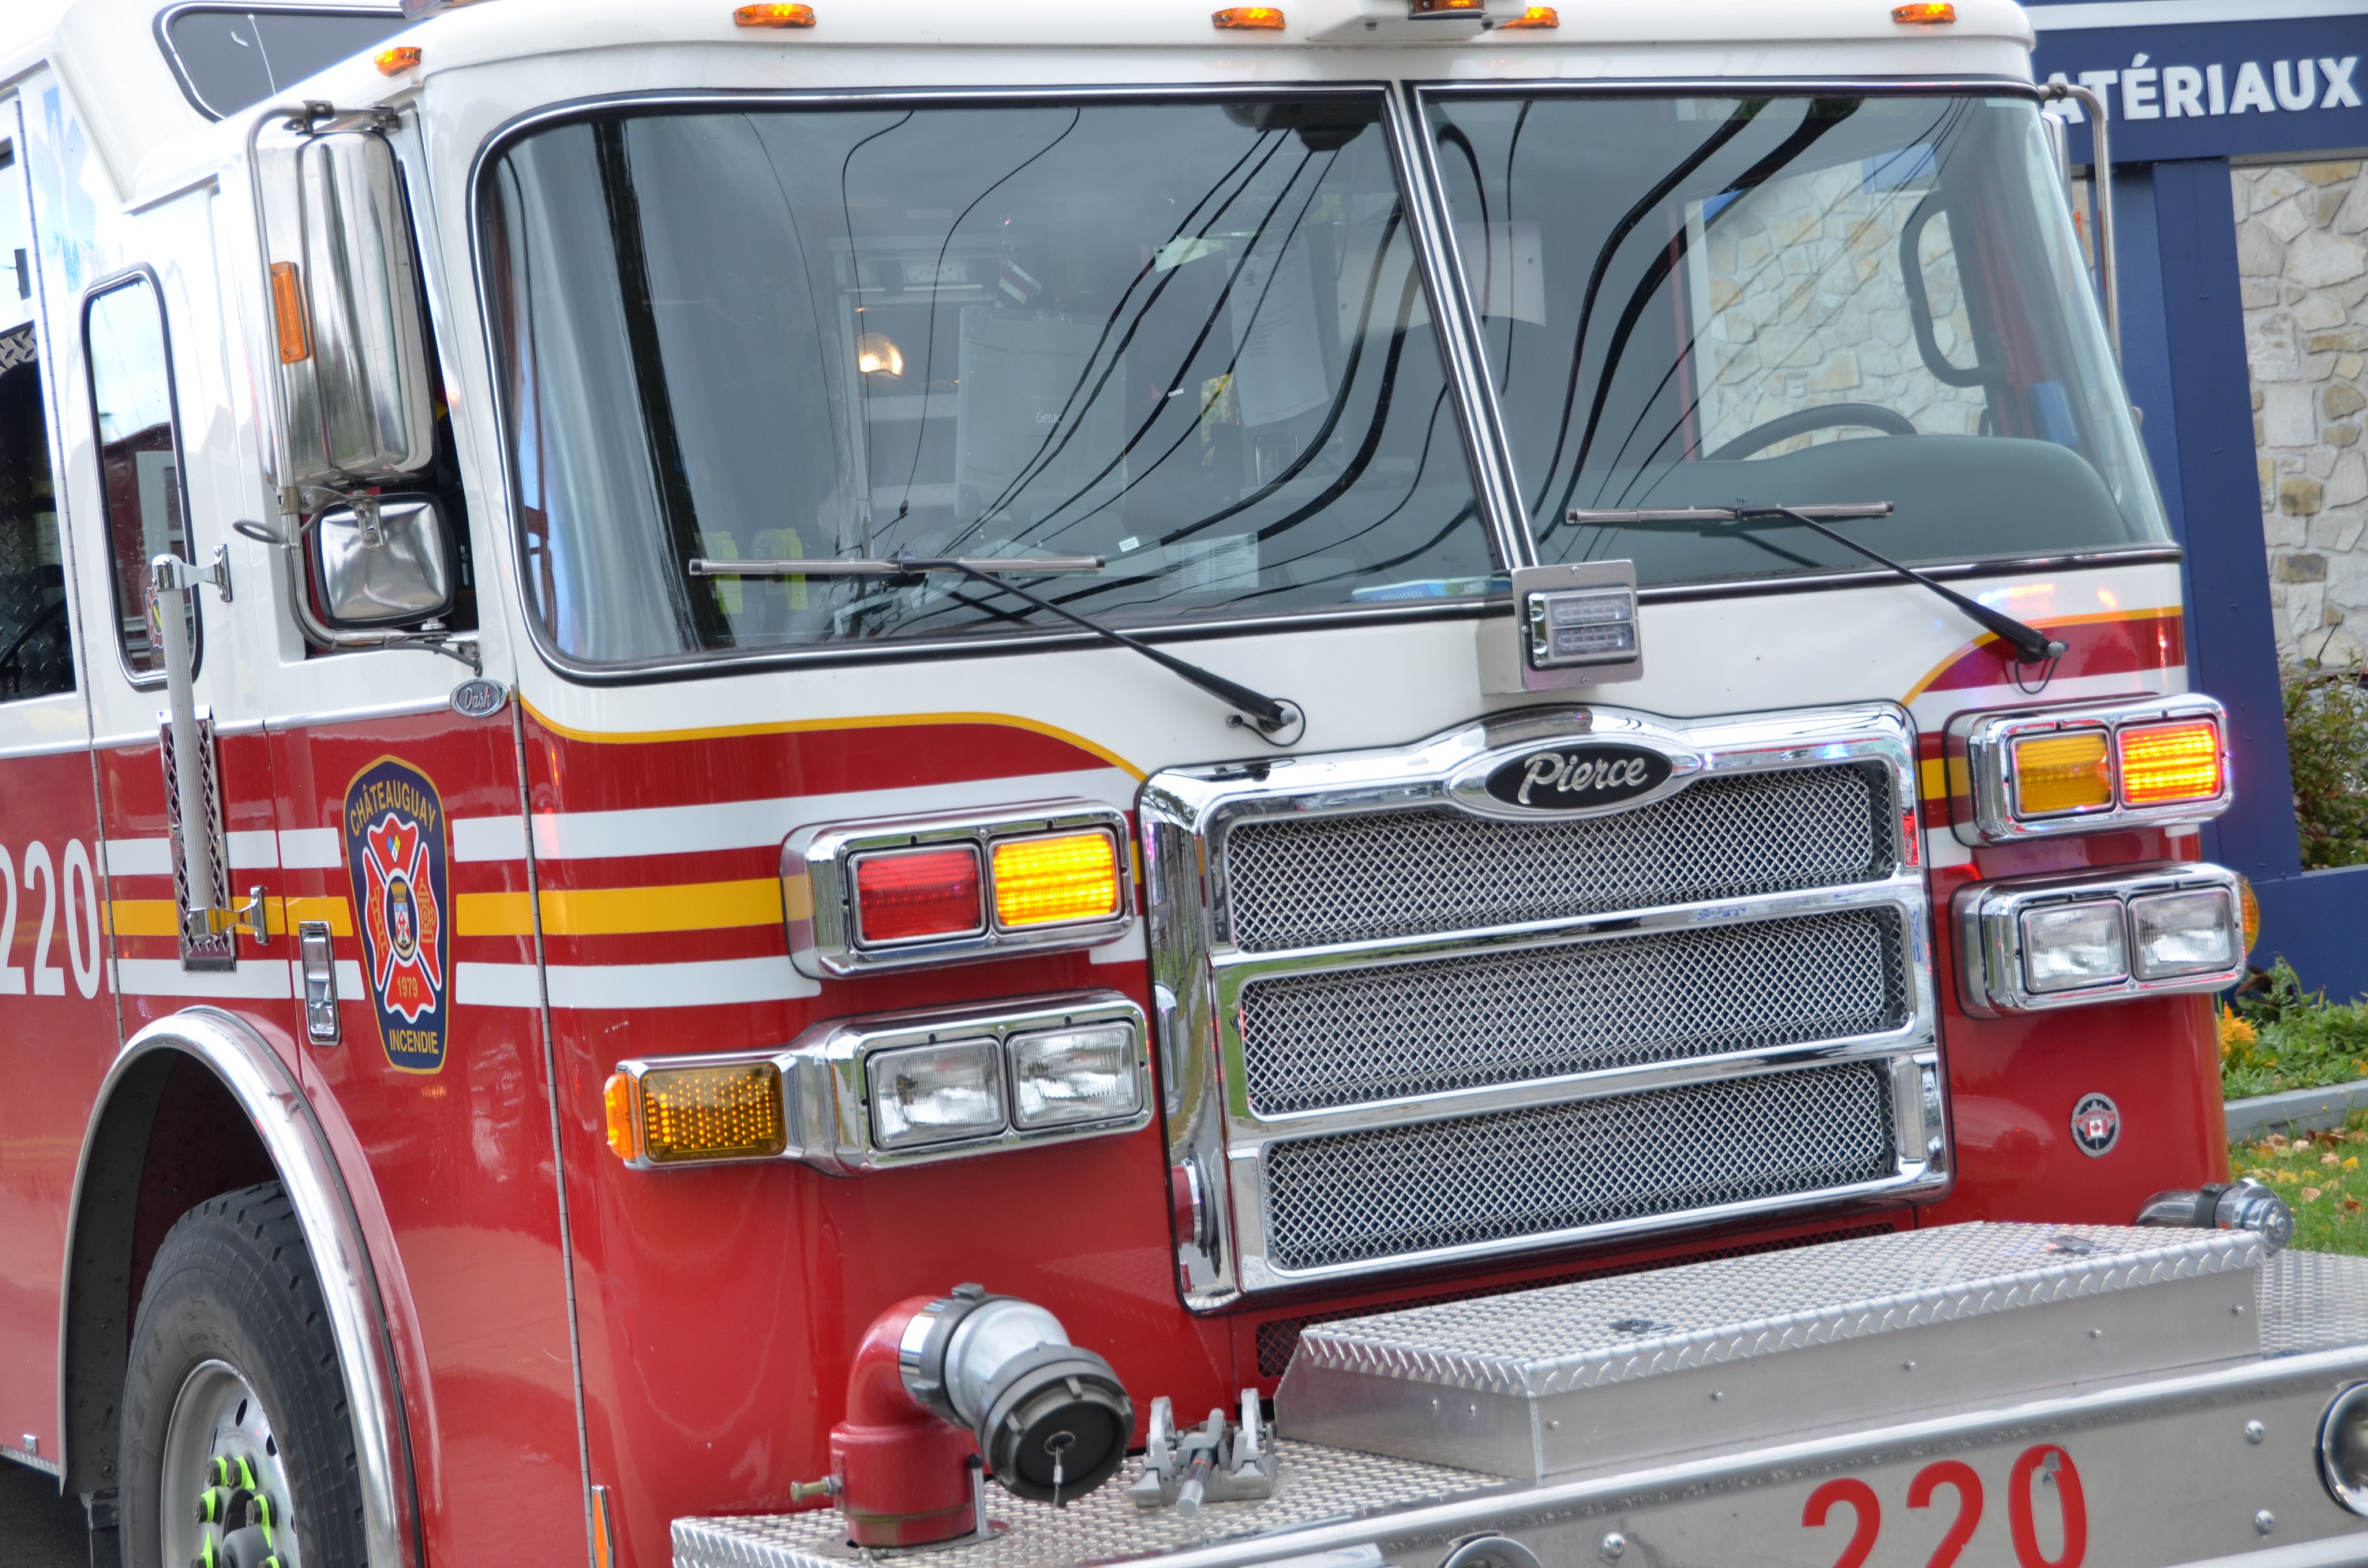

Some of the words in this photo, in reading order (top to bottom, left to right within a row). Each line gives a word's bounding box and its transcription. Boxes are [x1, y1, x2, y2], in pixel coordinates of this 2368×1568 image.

[1036, 410, 1062, 424] Getac
[464, 687, 492, 710] Dash
[1517, 752, 1648, 805] Pierce
[350, 780, 437, 836] CHÂTEAUGUAY
[0, 838, 101, 1000] 220
[397, 976, 418, 999] 1979
[389, 1029, 439, 1054] INCENDIE
[1801, 1443, 2087, 1568] 220
